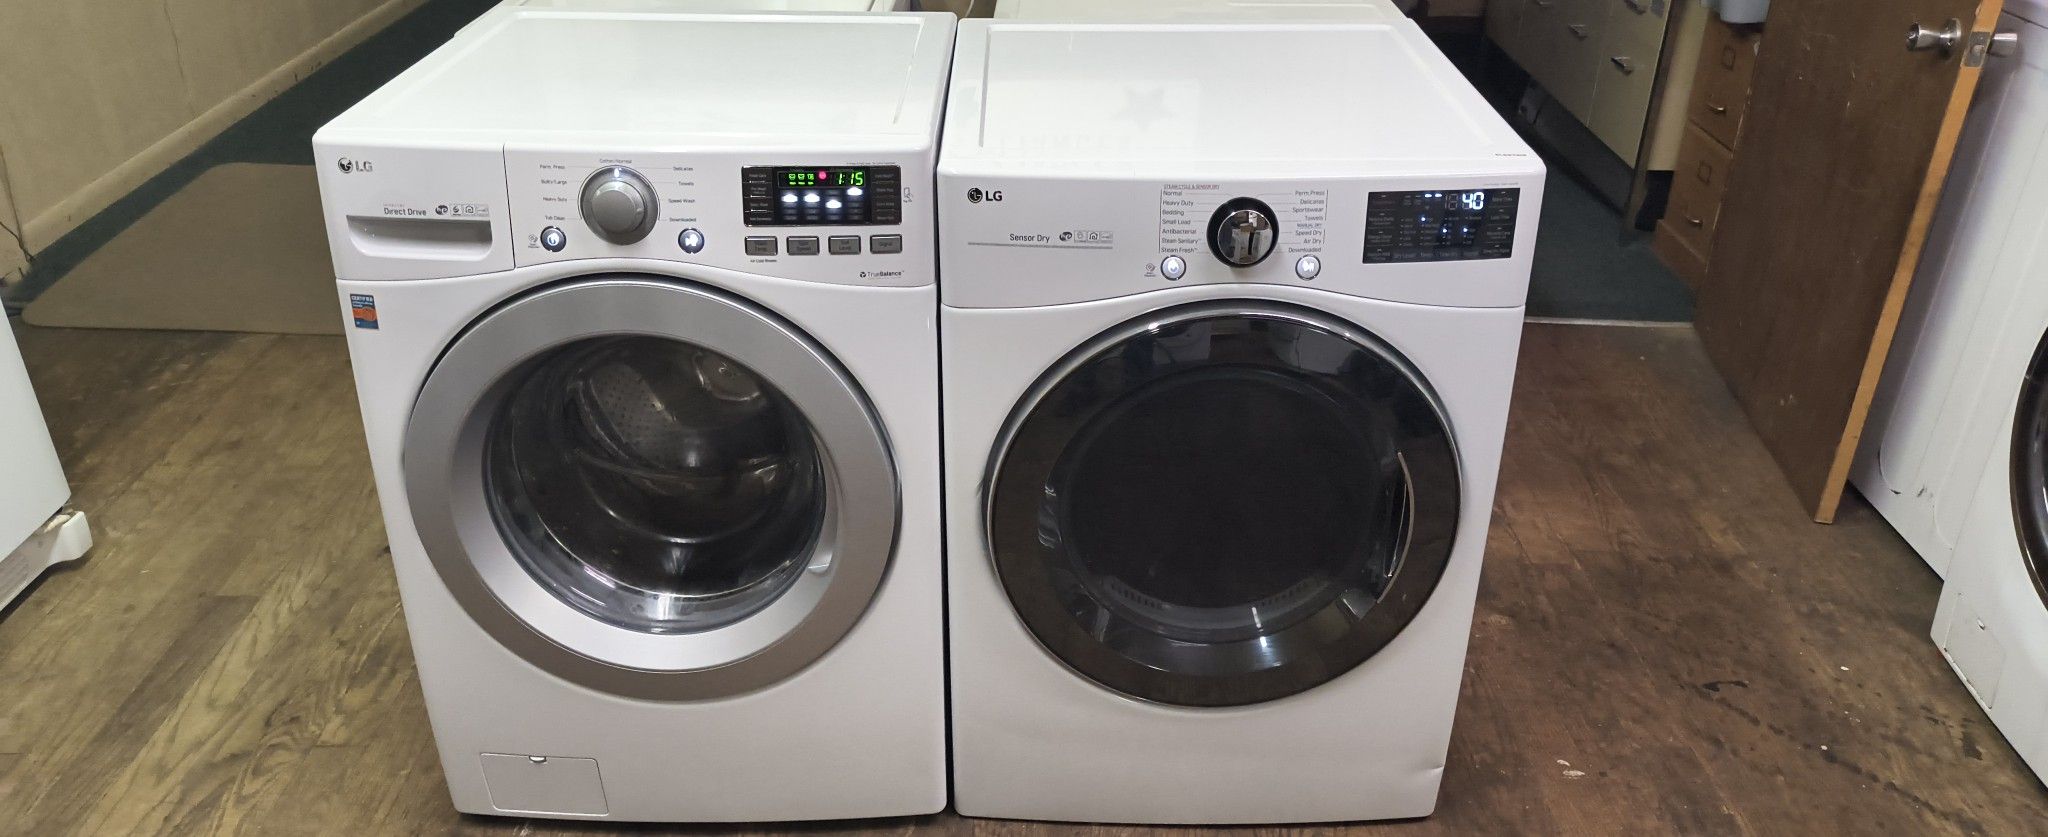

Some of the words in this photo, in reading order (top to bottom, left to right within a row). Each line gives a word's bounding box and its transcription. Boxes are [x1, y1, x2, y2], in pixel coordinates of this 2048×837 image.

[354, 160, 373, 172] LG
[837, 171, 864, 187] 1:15
[985, 190, 1003, 202] LG
[1461, 191, 1484, 210] 40
[383, 207, 406, 216] Direct
[407, 208, 427, 217] Drive
[1009, 233, 1035, 242] Sensor
[1036, 233, 1050, 244] Dry
